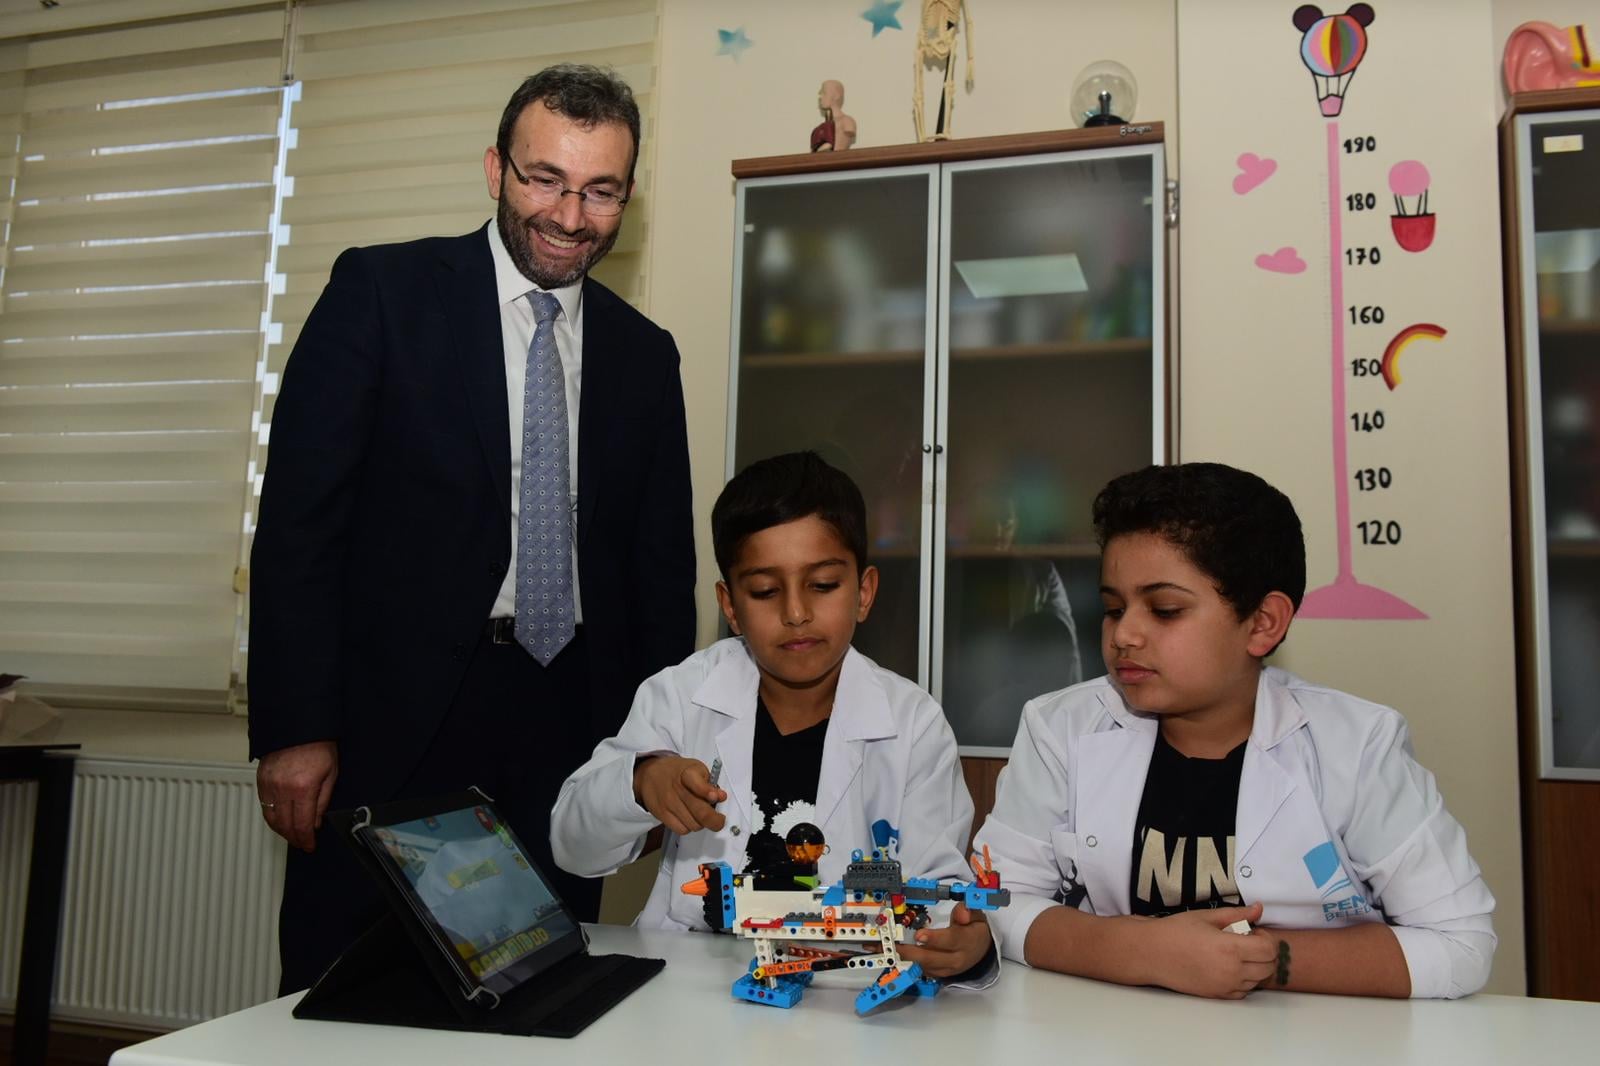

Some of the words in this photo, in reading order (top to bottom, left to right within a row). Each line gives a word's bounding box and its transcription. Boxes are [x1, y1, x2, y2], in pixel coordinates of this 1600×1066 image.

[1343, 136, 1376, 153] 190
[1346, 192, 1376, 211] 180
[1345, 247, 1381, 265] 170
[1348, 305, 1385, 325] 160
[1351, 358, 1382, 377] 150
[1351, 410, 1385, 432] 140
[1354, 467, 1392, 491] 130
[1357, 520, 1401, 545] 120
[1137, 825, 1240, 907] NN
